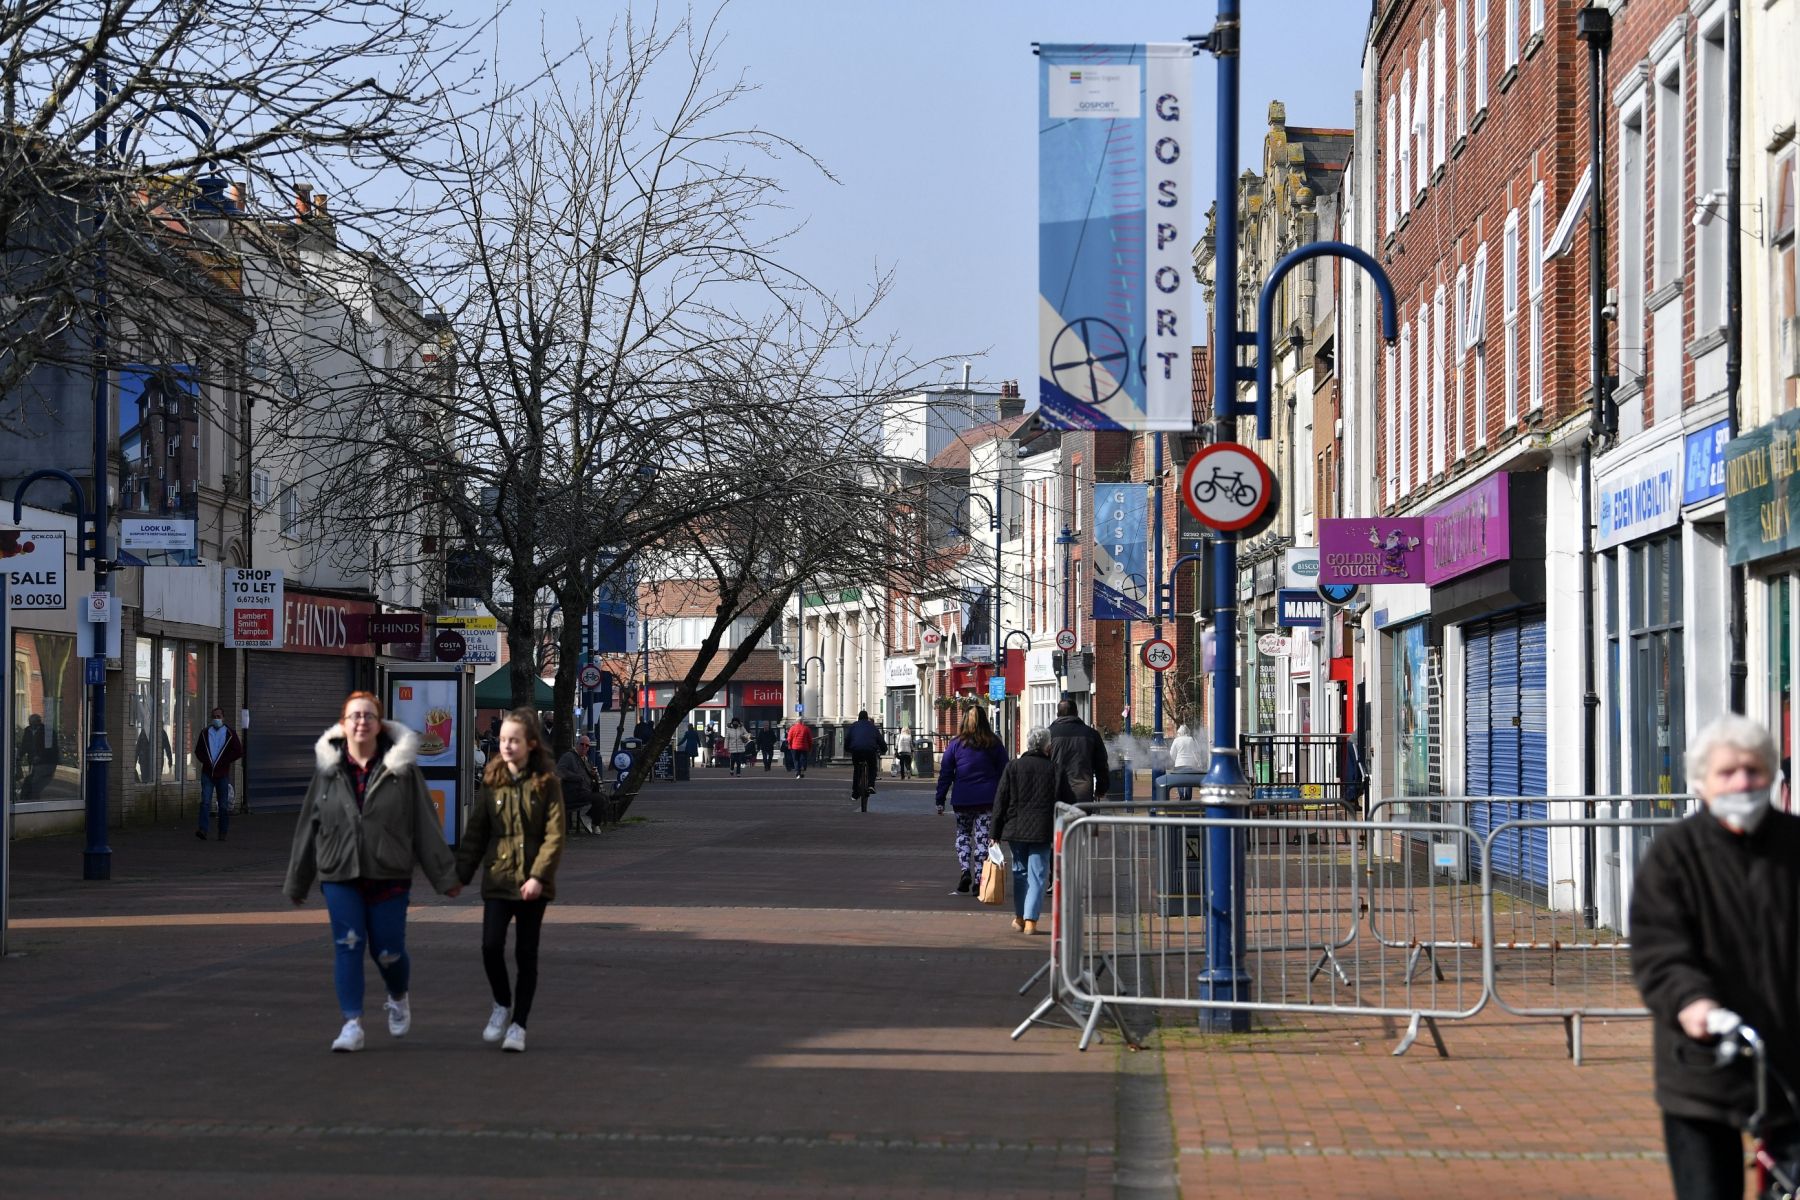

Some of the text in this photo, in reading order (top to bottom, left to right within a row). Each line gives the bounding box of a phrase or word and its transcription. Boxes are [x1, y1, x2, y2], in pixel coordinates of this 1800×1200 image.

[1155, 93, 1180, 380] GOSPORT
[1727, 447, 1768, 498] ORIENTAL
[1614, 468, 1672, 530] EDEN MOBILITY
[1326, 553, 1381, 566] GOLDEN
[238, 570, 272, 580] SHOP
[1331, 566, 1378, 577] TOUCH
[11, 572, 56, 584] SALE
[232, 582, 276, 593] TO LET
[27, 594, 62, 605] 0030
[284, 601, 347, 648] F.HINDS
[374, 624, 420, 632] F.HINDS
[753, 689, 782, 700] Fairh
